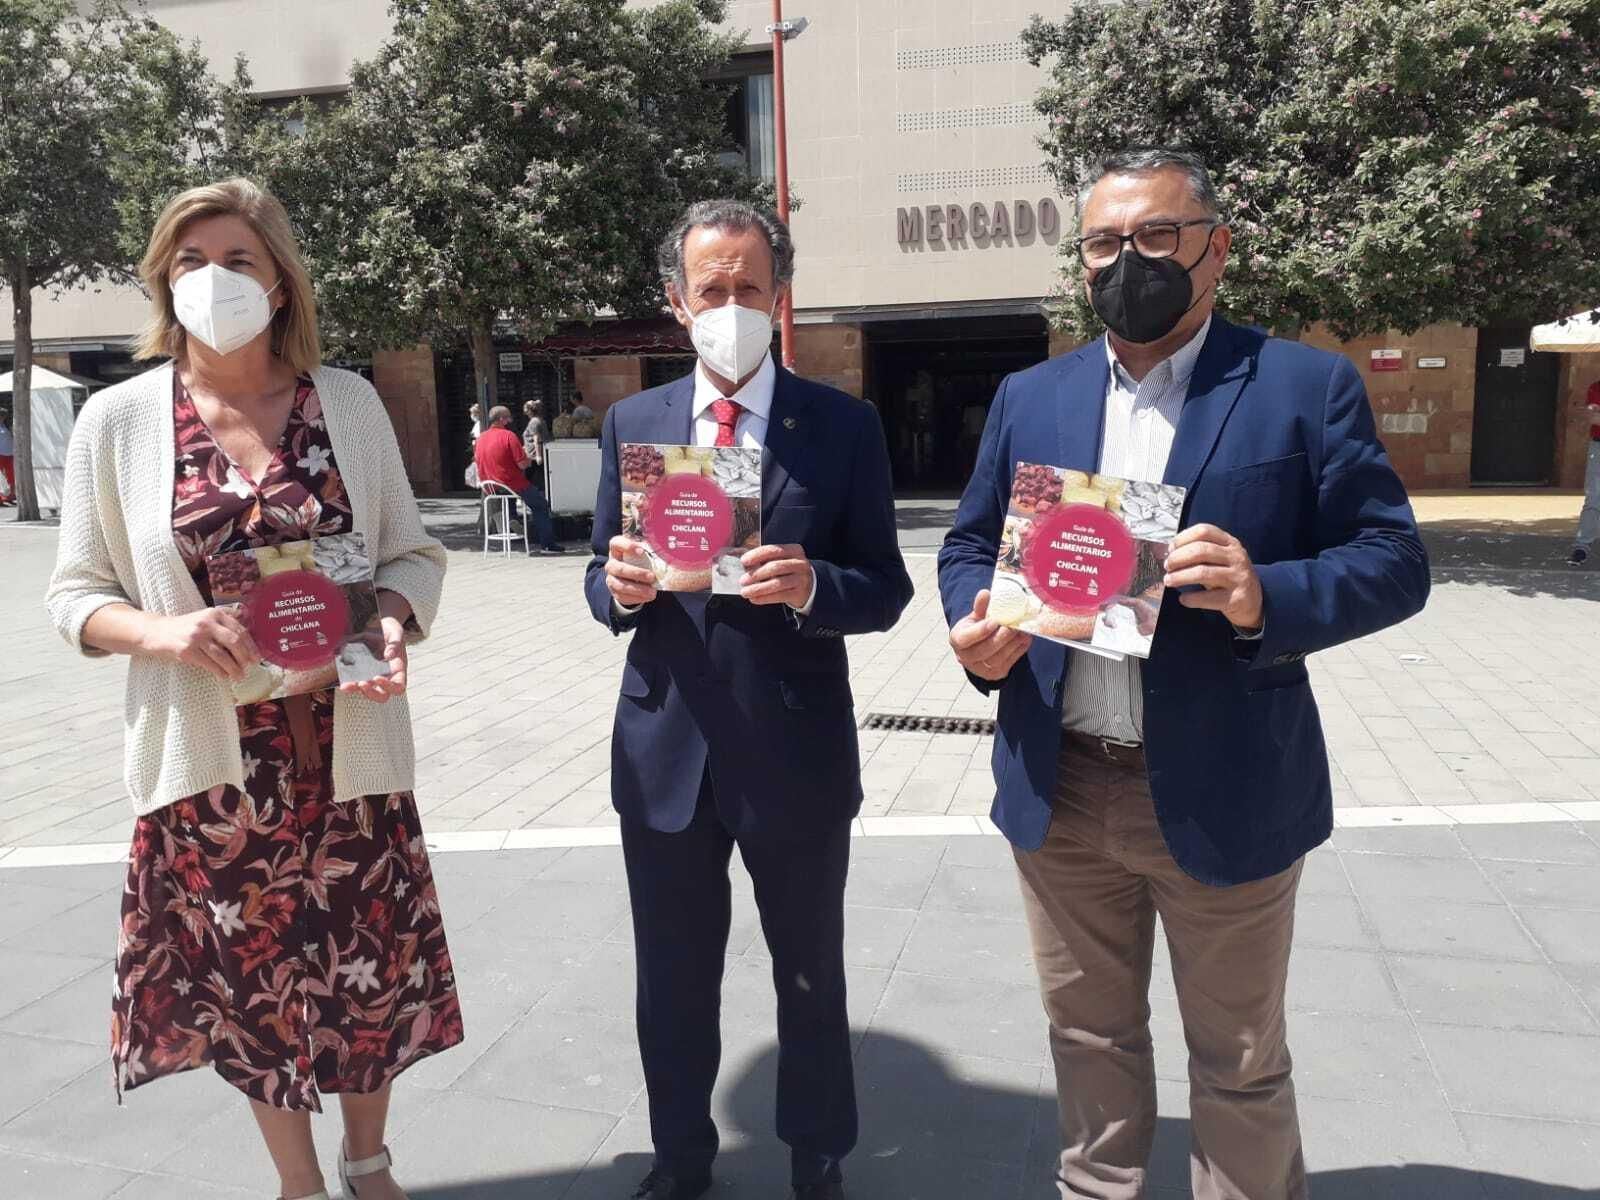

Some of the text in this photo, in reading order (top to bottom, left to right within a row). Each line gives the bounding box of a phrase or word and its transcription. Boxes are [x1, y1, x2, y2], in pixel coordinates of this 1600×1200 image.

[897, 198, 1057, 244] MERCADO
[671, 499, 708, 508] RECURSOS
[664, 508, 715, 518] ALIMENTARIOS
[671, 524, 706, 533] CHICLANA
[1061, 531, 1105, 546] RECURSOS
[1050, 540, 1113, 559] ALIMENTARIOS
[1056, 560, 1099, 575] CHICLANA
[274, 594, 316, 608] RECURSOS
[268, 602, 326, 619] ALIMENTARIOS
[280, 620, 321, 633] CHICLANA
